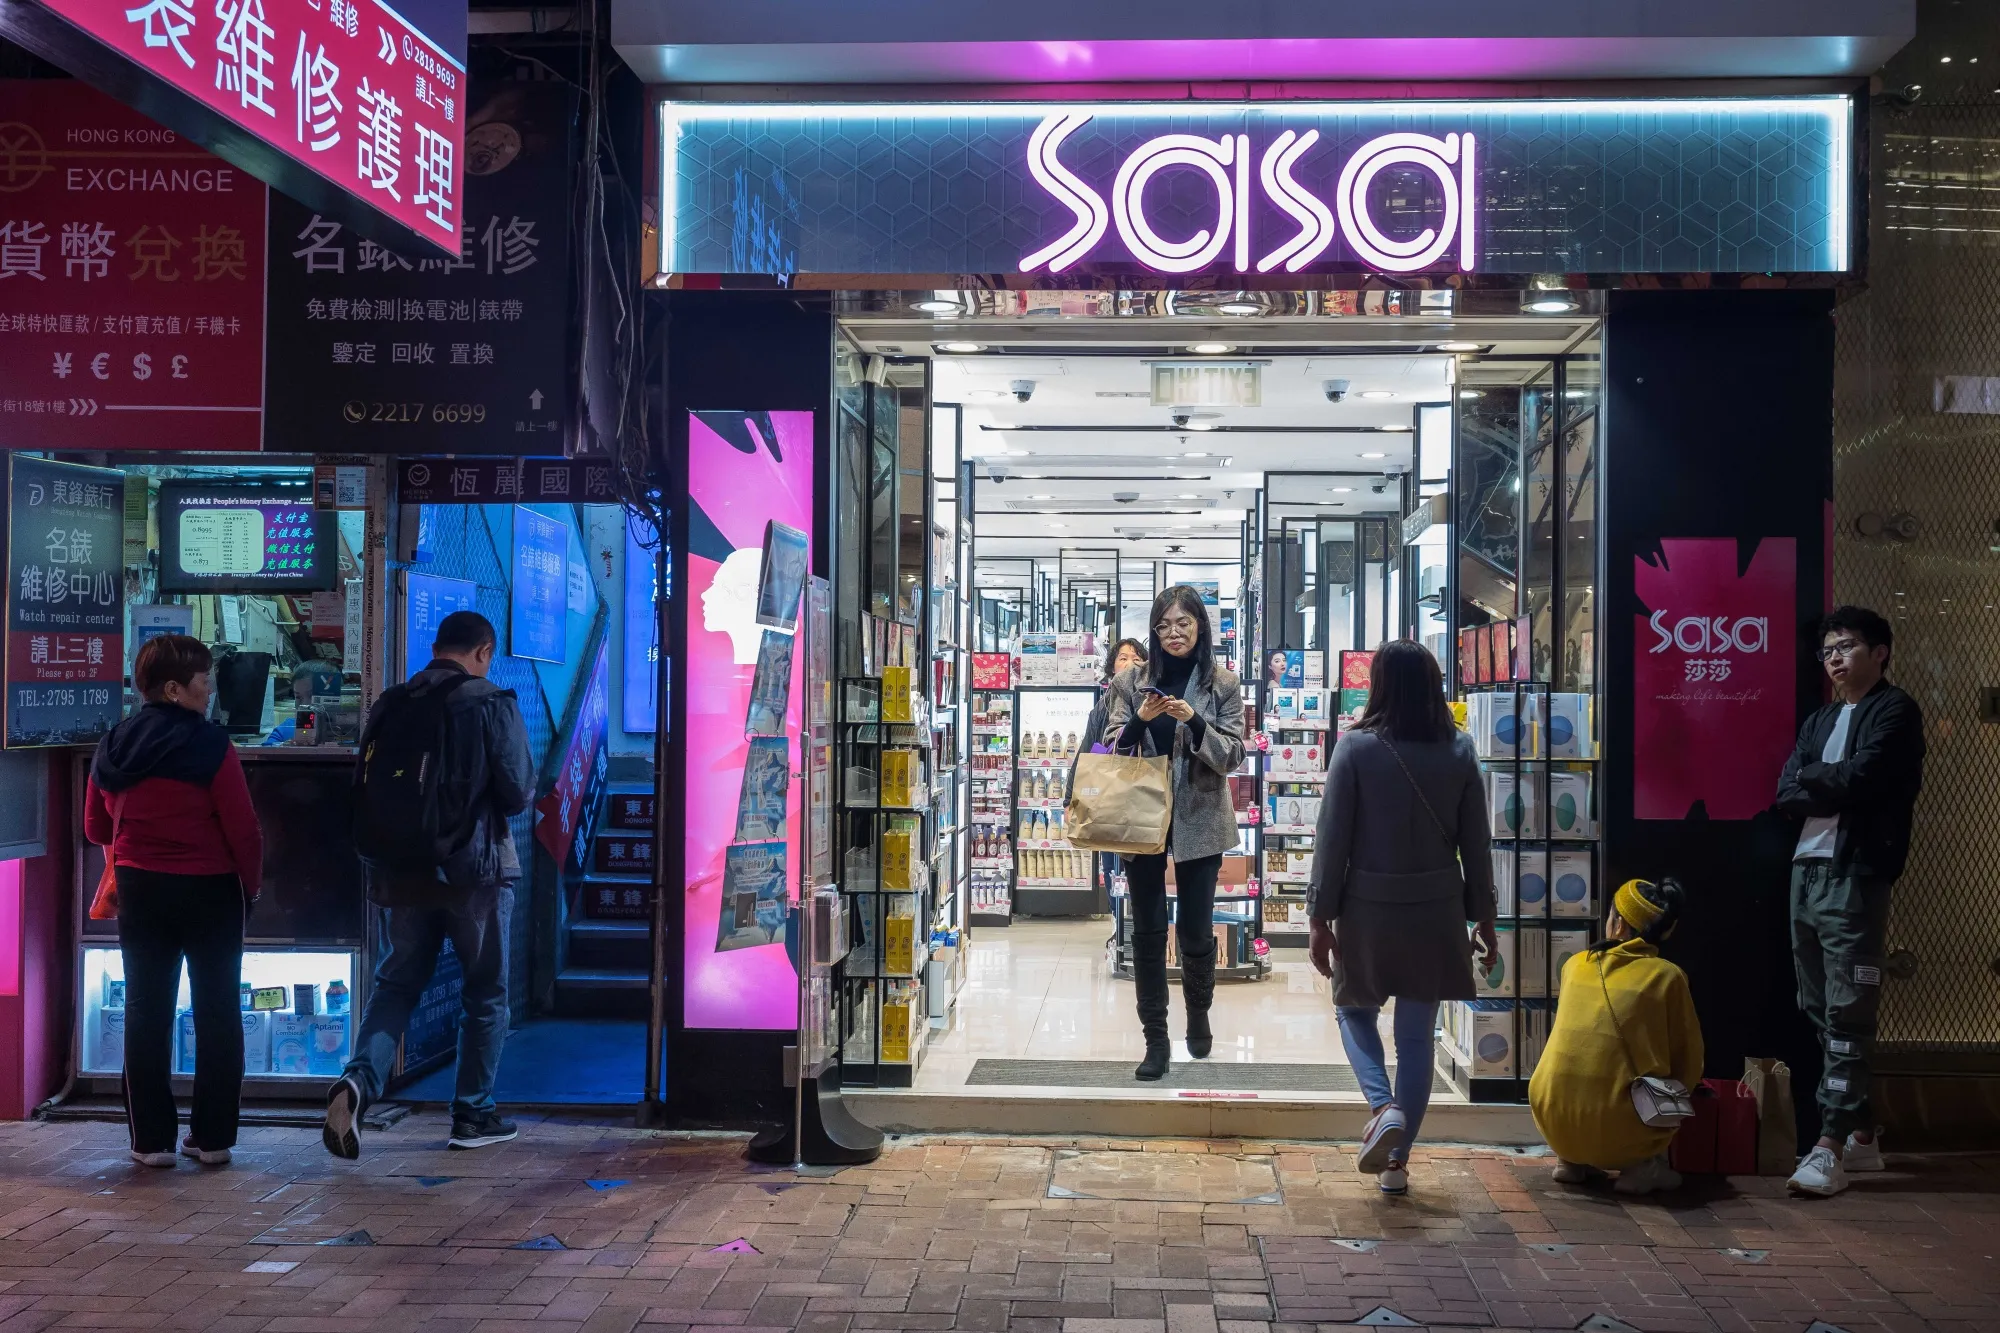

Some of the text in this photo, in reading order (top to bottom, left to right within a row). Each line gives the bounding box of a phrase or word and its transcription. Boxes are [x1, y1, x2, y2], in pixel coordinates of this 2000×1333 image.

[414, 46, 455, 90] 2818 9693
[415, 73, 455, 123] 請上一樓
[66, 129, 176, 144] HONG KONG
[66, 168, 234, 193] EXCHANGE
[193, 315, 241, 336] 手機卡
[391, 342, 435, 364] 回收
[449, 342, 494, 364] 置換
[0, 399, 66, 413] 街18號1樓
[371, 403, 486, 423] 2217 6699
[213, 497, 239, 506] People's
[239, 498, 261, 506] Money
[261, 497, 292, 506] Exchange
[45, 526, 93, 566] 名錶
[20, 564, 116, 606] 維修中心
[19, 608, 115, 625] Watch repair center
[30, 635, 104, 665] 請上三樓
[37, 667, 98, 680] Please go to 2F
[1684, 658, 1732, 682] 莎莎
[82, 688, 109, 706] 1789
[1655, 688, 1760, 706] making life beautiful
[624, 816, 654, 824] DONGFEN
[314, 1023, 344, 1032] Aptamil
